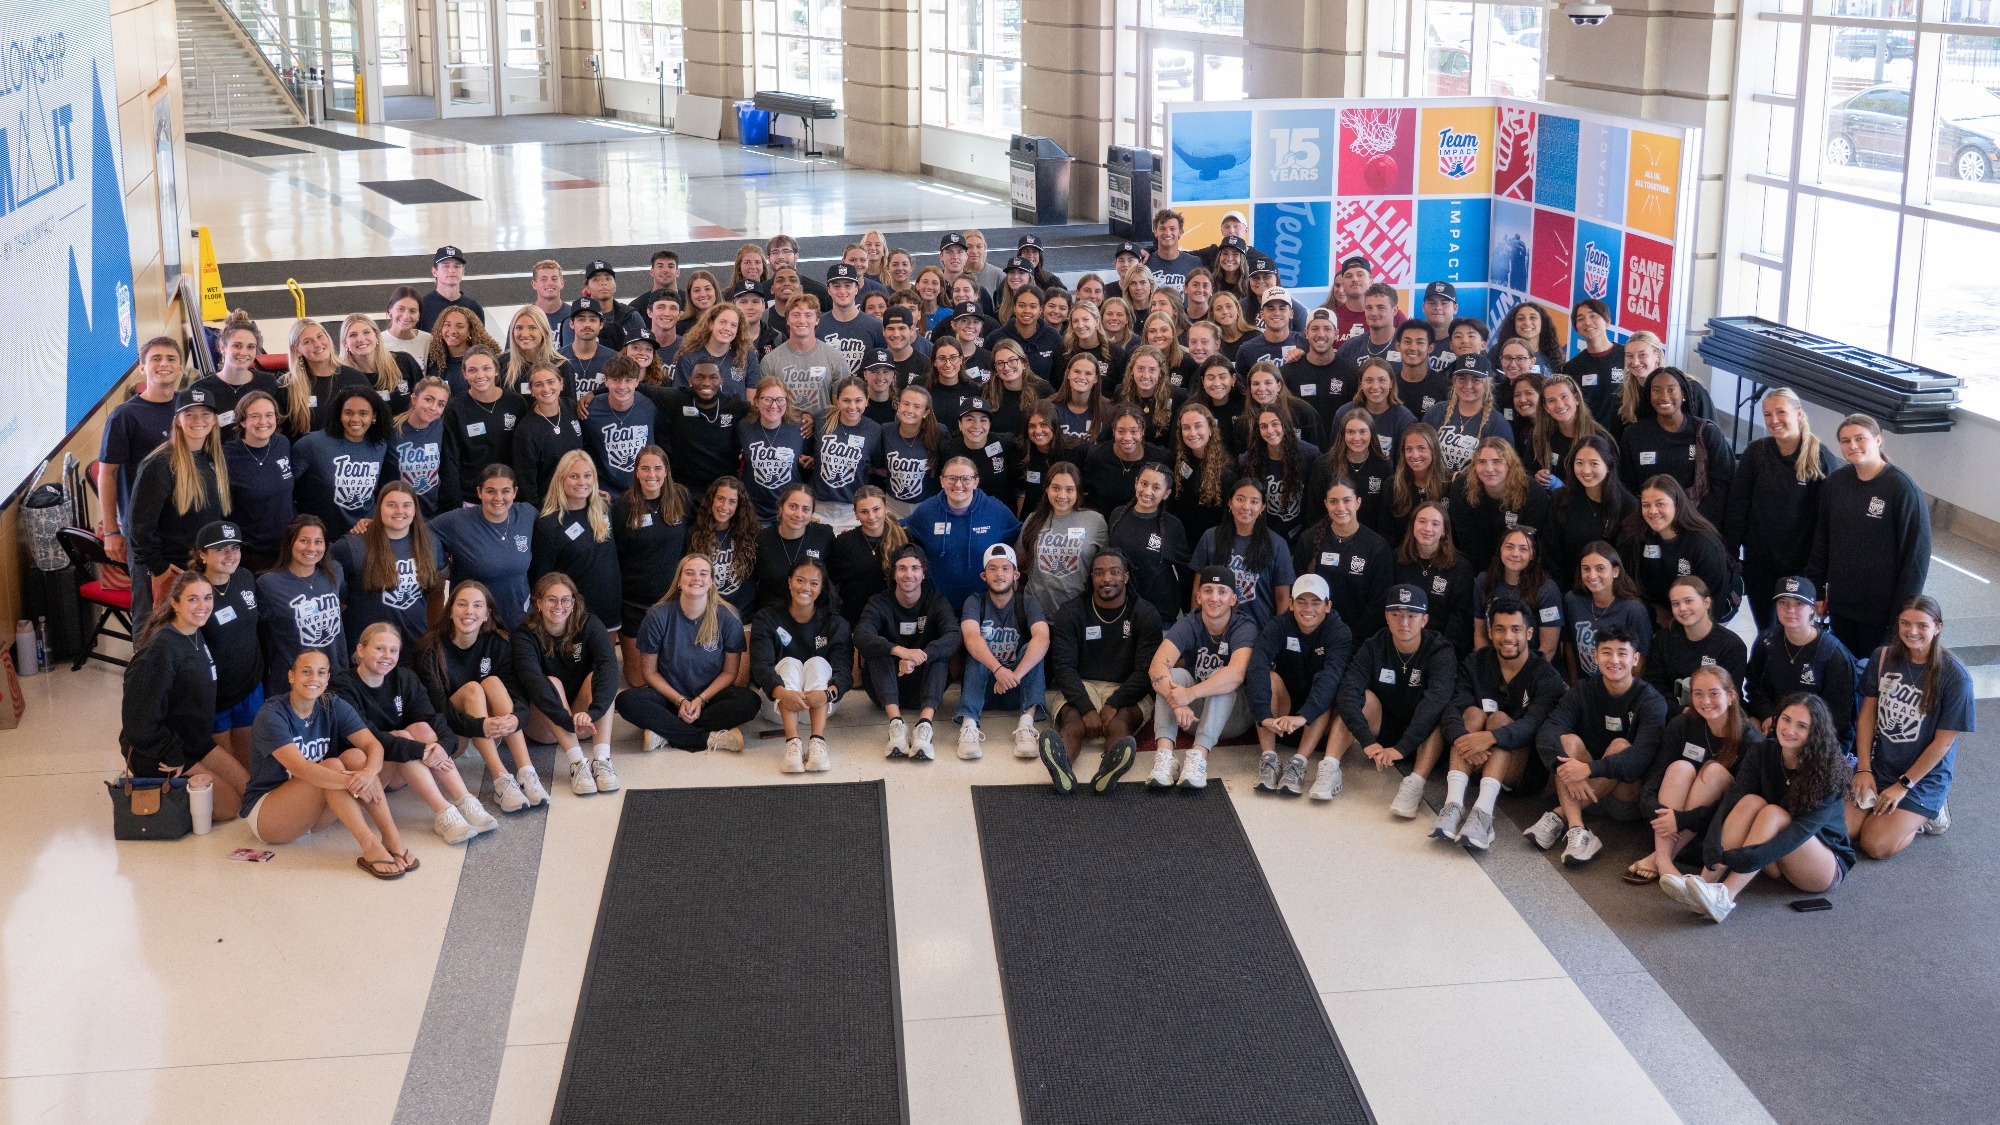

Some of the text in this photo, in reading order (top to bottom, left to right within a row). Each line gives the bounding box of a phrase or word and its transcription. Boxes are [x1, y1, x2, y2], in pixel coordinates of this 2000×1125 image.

[1269, 127, 1320, 169] 15
[1439, 128, 1478, 148] Team
[1269, 167, 1319, 182] YEARS
[1596, 128, 1608, 218] IMPACT
[1635, 179, 1644, 188] ALL
[1644, 170, 1653, 179] ALL
[1275, 201, 1316, 288] Team
[1447, 201, 1462, 282] IMPACT
[1585, 242, 1610, 269] Team
[1629, 255, 1665, 277] GAME
[1585, 265, 1609, 278] IMPACT
[1628, 271, 1665, 304] DAY
[1627, 296, 1661, 323] GALA
[822, 435, 861, 461] Team
[821, 455, 857, 468] IMPACT
[336, 478, 378, 486] IMPACT
[1879, 696, 1916, 718] IMPAC
